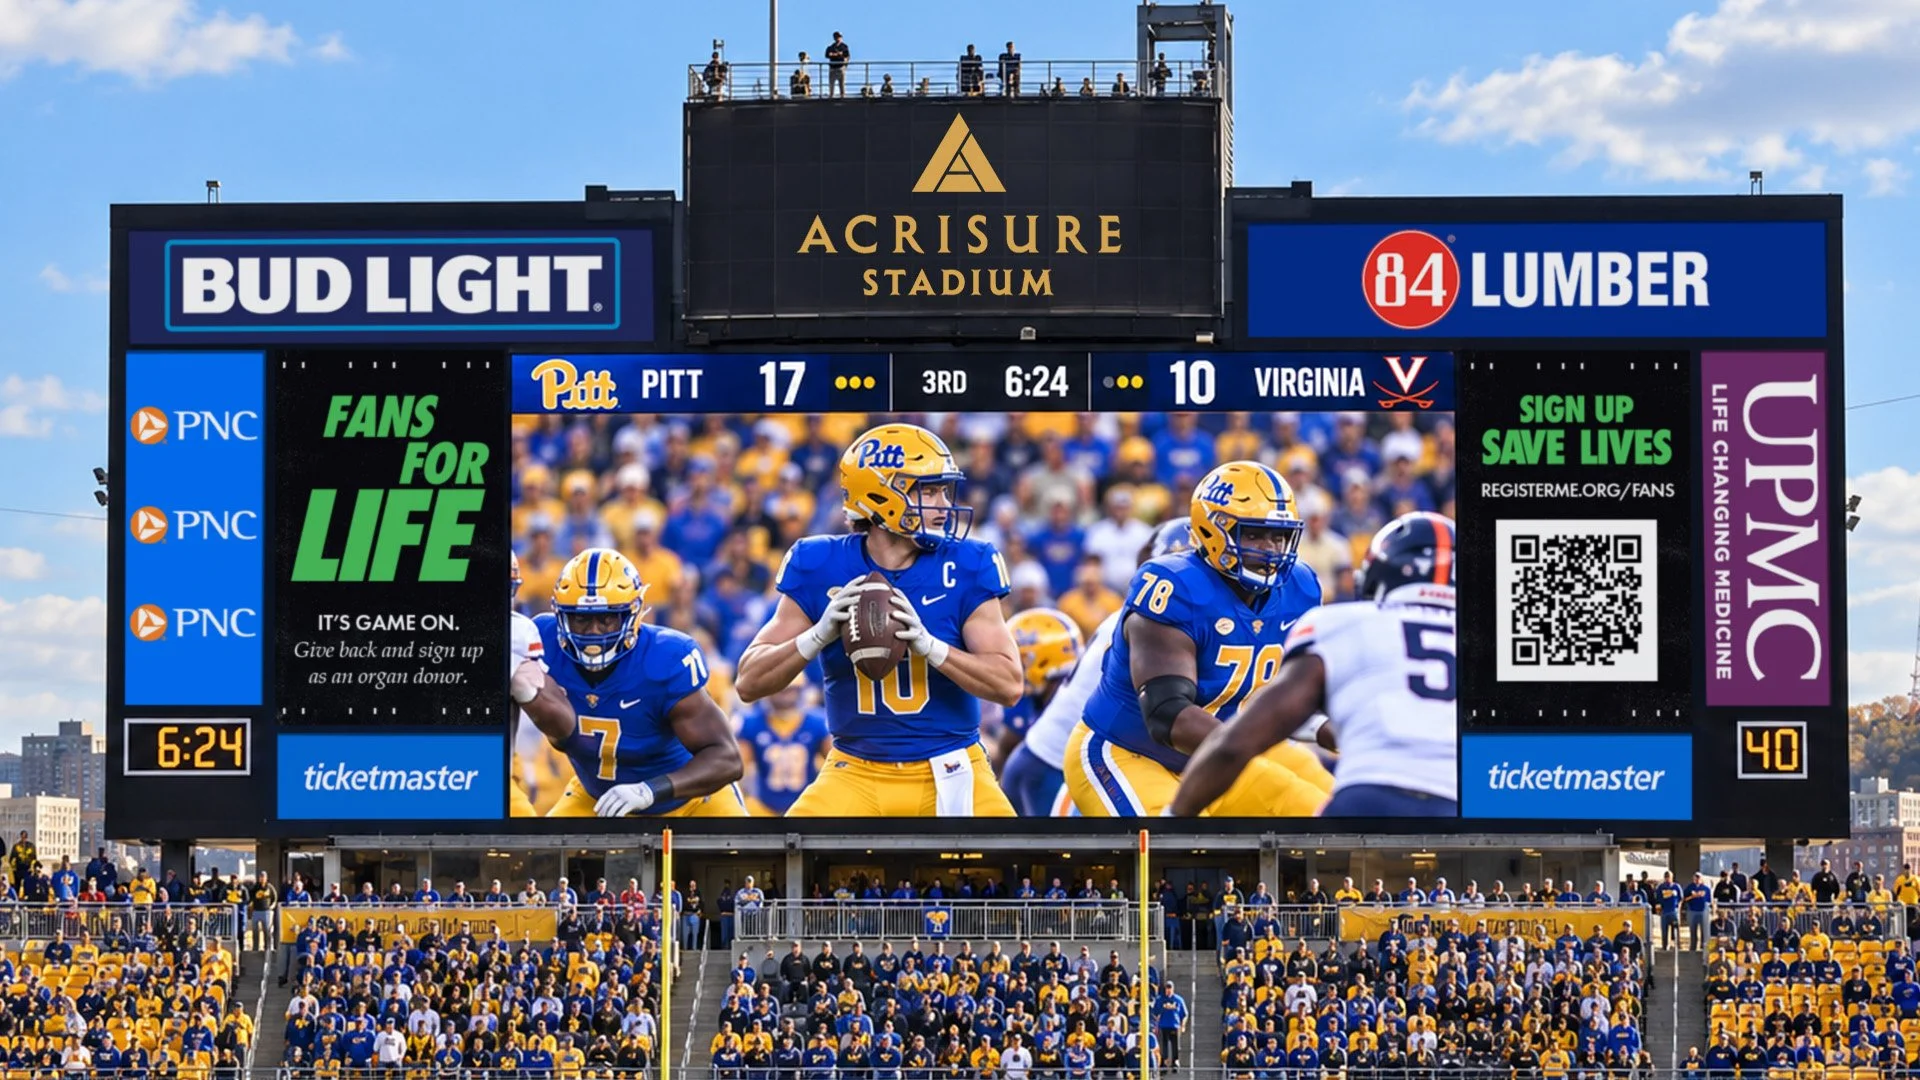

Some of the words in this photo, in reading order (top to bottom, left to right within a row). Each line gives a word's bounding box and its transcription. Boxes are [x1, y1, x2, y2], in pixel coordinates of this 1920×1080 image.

[798, 214, 1122, 254] ACRISURE
[182, 256, 352, 314] BUD
[366, 254, 603, 314] LIGHT
[863, 268, 1054, 296] STADIUM
[1375, 252, 1447, 307] 84
[1471, 251, 1710, 308] LUMBER
[531, 358, 619, 410] Pitt
[641, 369, 703, 399] PITT
[759, 361, 805, 405] 17
[922, 370, 967, 394] 3RD
[1004, 365, 1069, 398] 6:24
[1169, 360, 1216, 405] 10
[1254, 367, 1366, 398] VIRGINIA
[174, 410, 258, 441] PNC
[323, 394, 439, 439] FANS
[1519, 394, 1586, 424] SIGN
[1594, 394, 1634, 424] UP
[1712, 384, 1729, 433] LIFE
[398, 441, 490, 485] FOR
[857, 438, 906, 469] Pitt
[1481, 428, 1566, 466] SAVE
[1580, 428, 1673, 466] LIVES
[1481, 482, 1675, 501] REGISTERME.ORG/FANS
[1712, 439, 1731, 562] CHANGING
[173, 510, 257, 540] PNC
[290, 488, 486, 582] LIFE
[1742, 373, 1822, 681] UPMC
[943, 561, 957, 588] C
[1132, 571, 1175, 615] 78
[173, 607, 256, 638] PNC
[318, 614, 351, 631] IT'S
[355, 614, 416, 631] GAME
[420, 614, 460, 631] ON.
[1714, 569, 1732, 680] MEDICINE
[294, 641, 335, 658] Give
[339, 640, 378, 658] back
[381, 641, 414, 658] and
[418, 641, 455, 663] sign
[461, 646, 484, 663] up
[1402, 620, 1455, 702] 5
[308, 672, 327, 684] as
[331, 672, 353, 684] an
[357, 671, 408, 690] organ
[412, 667, 468, 684] donor.
[157, 725, 242, 768] 6:24
[1745, 728, 1800, 771] 40
[303, 762, 479, 791] ticketmaster
[1488, 761, 1666, 791] ticketmaster
